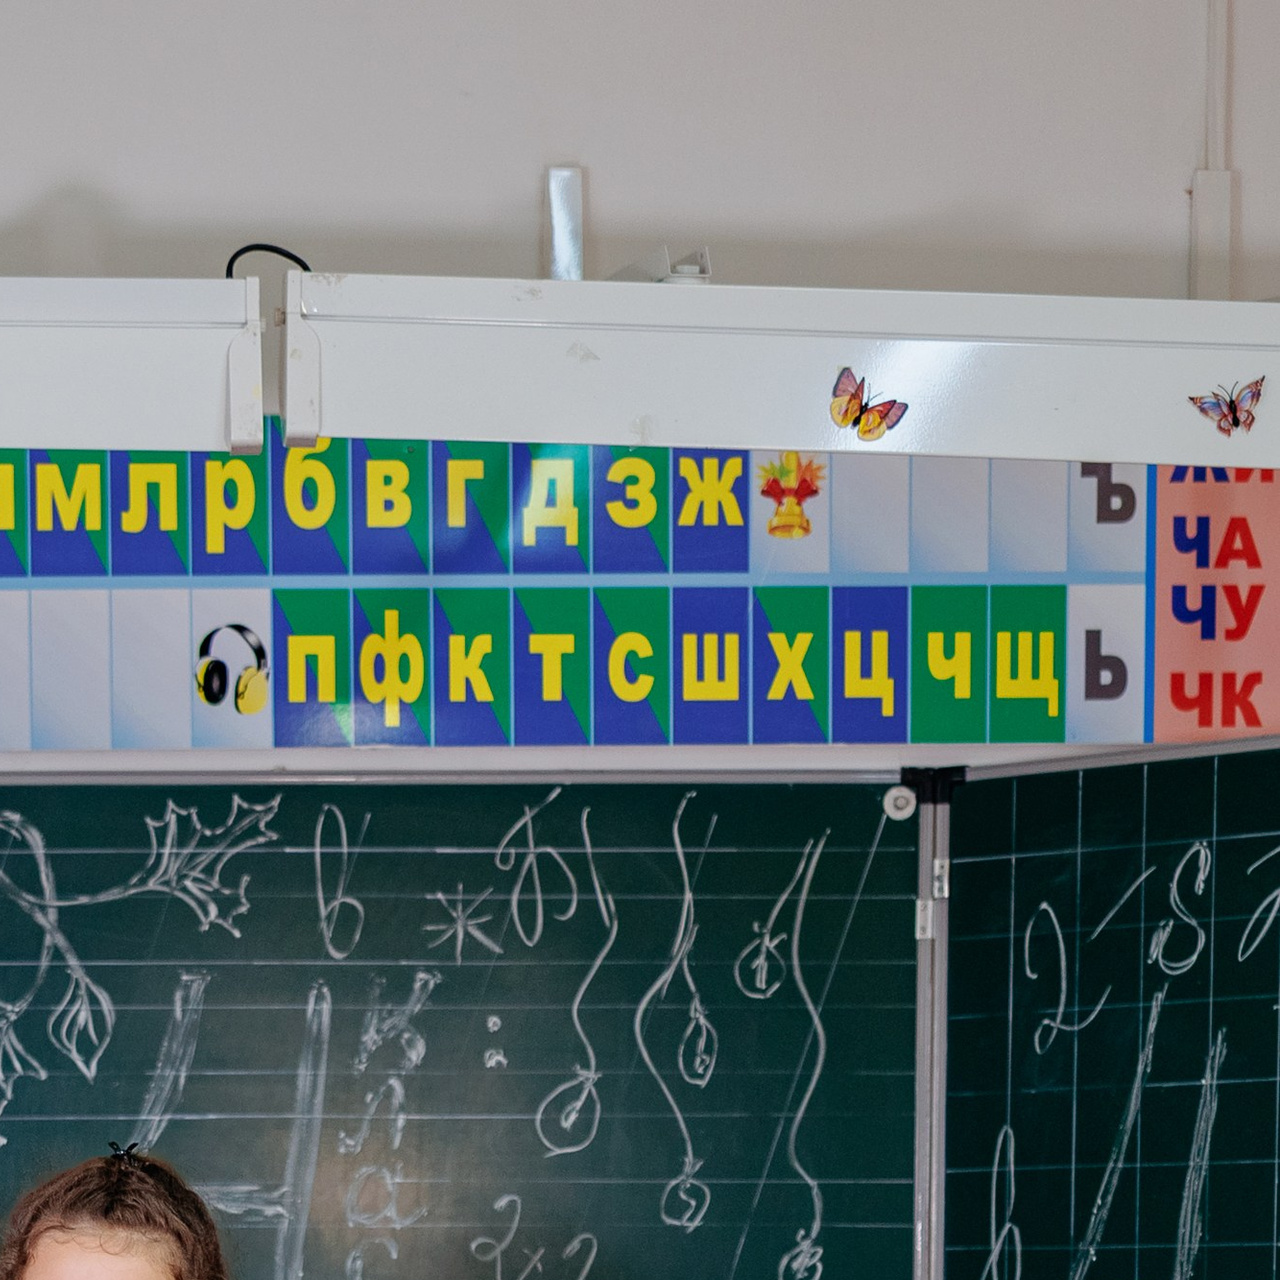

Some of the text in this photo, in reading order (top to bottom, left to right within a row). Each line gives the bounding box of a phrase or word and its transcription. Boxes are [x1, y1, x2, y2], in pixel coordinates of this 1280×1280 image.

[1173, 516, 1262, 569] ЧА
[1172, 585, 1265, 641] ЧУ
[1170, 672, 1263, 728] ЧК
